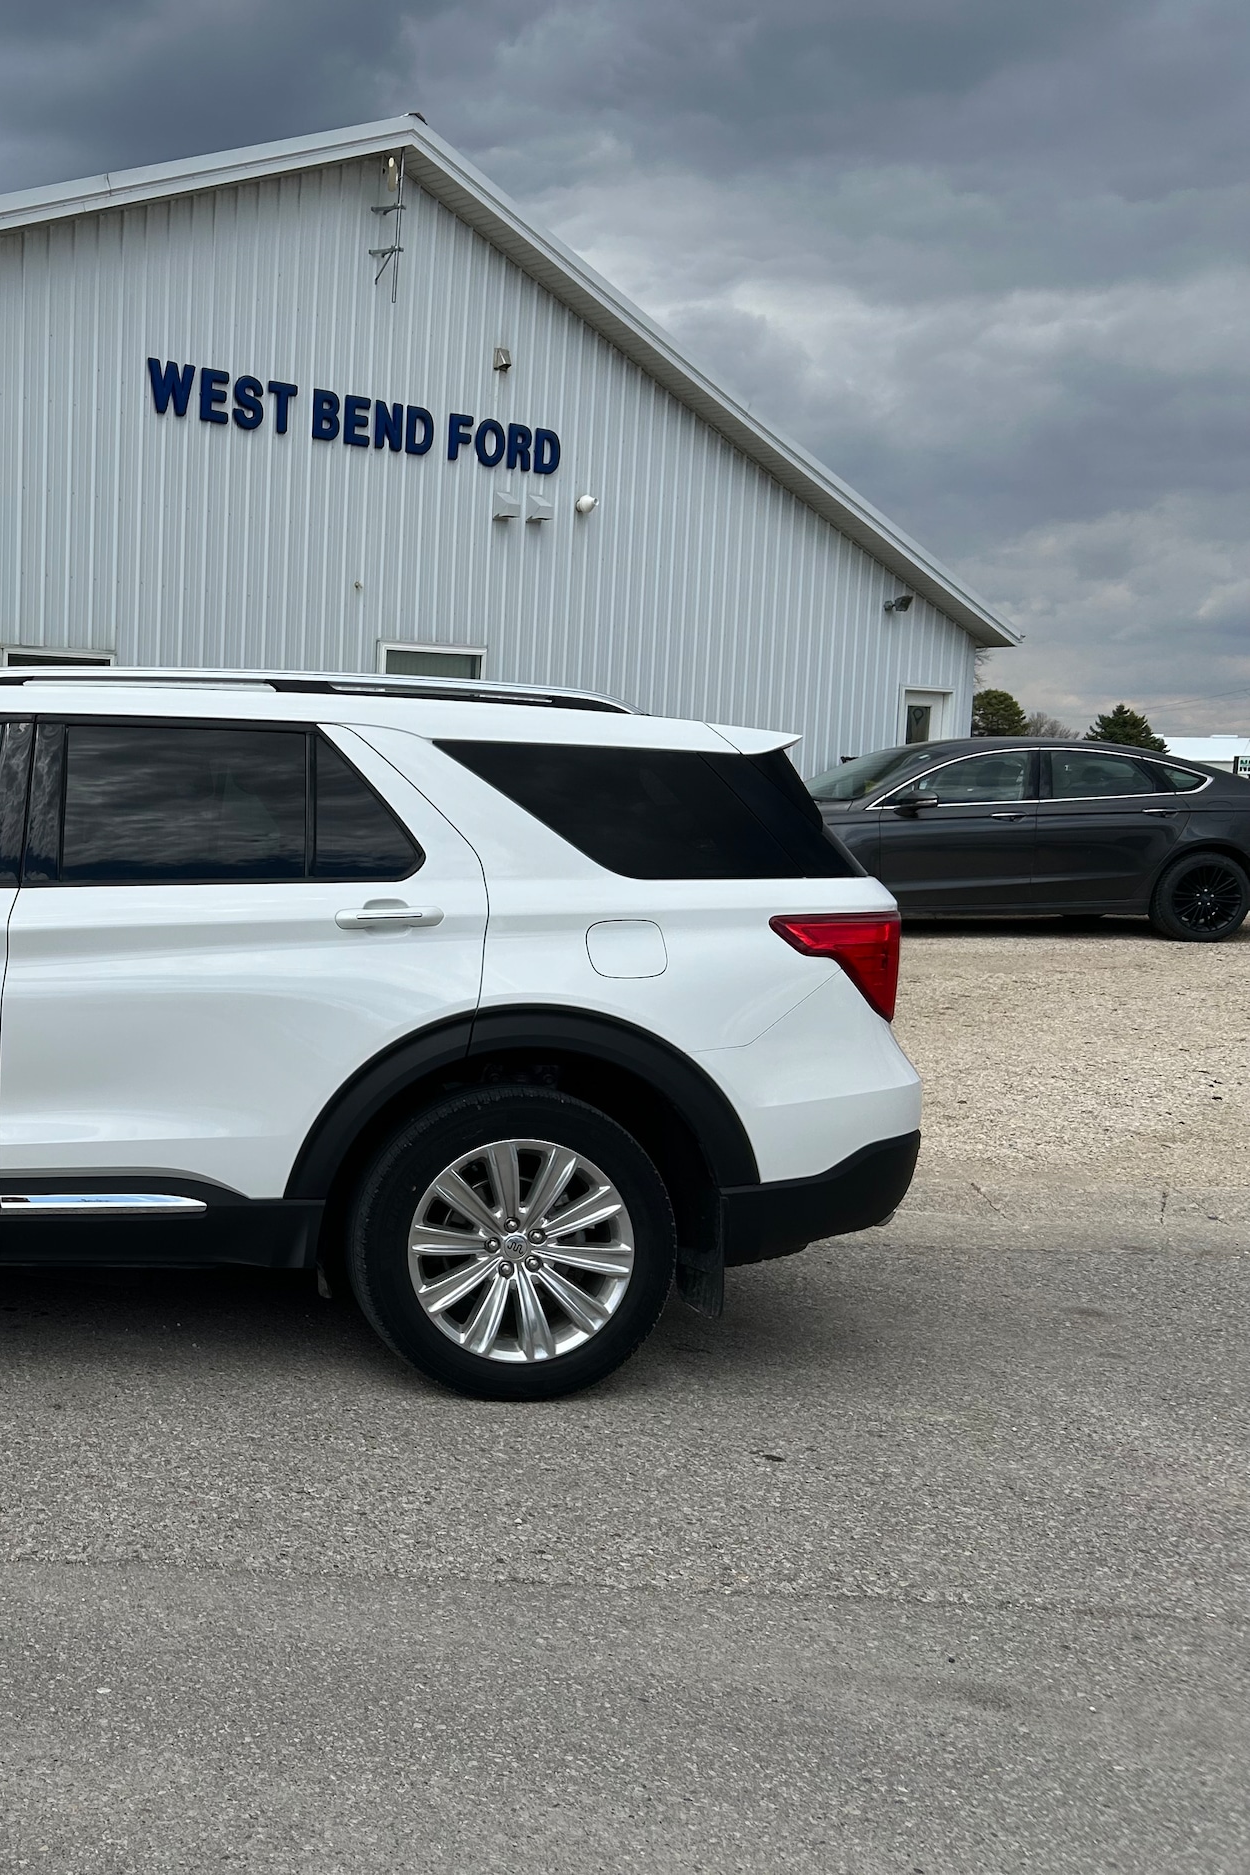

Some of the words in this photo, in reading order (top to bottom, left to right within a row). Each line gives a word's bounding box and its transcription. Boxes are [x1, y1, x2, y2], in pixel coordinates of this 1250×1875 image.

[148, 357, 298, 434] WEST
[312, 388, 434, 455] BEND
[448, 413, 561, 475] FORD
